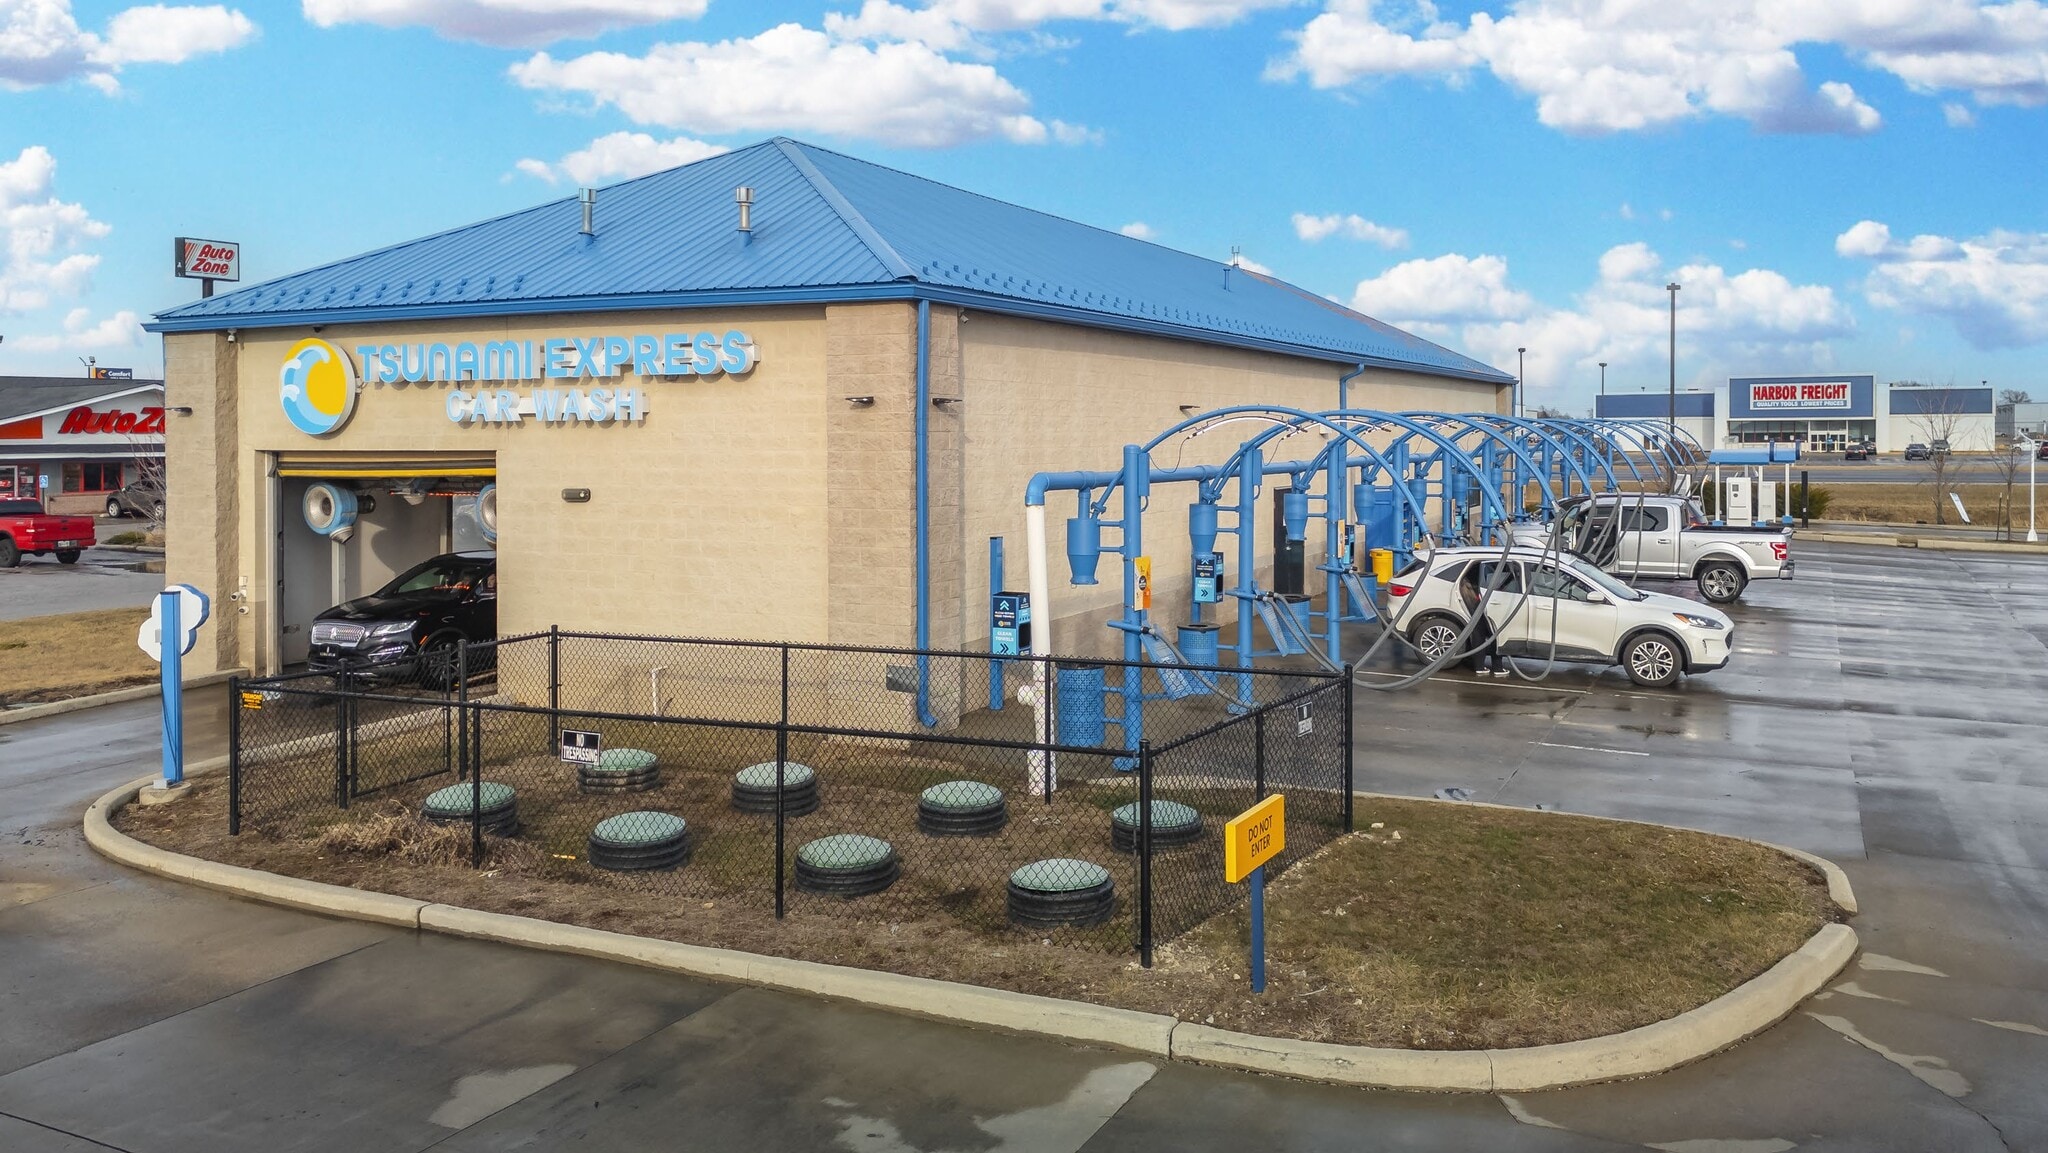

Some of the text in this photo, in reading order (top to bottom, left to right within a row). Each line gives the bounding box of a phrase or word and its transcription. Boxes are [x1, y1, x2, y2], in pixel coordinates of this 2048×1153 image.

[198, 244, 235, 261] Auto
[191, 257, 230, 275] Zone
[356, 330, 753, 384] TSUNAMI EXPRESS
[1753, 384, 1848, 401] HARBOR FREIGHT
[445, 386, 640, 423] CAR WASH
[576, 733, 585, 748] NO
[563, 745, 599, 762] TRESPASSING
[1248, 814, 1273, 843] DO NOT
[1251, 834, 1271, 857] ENTER
